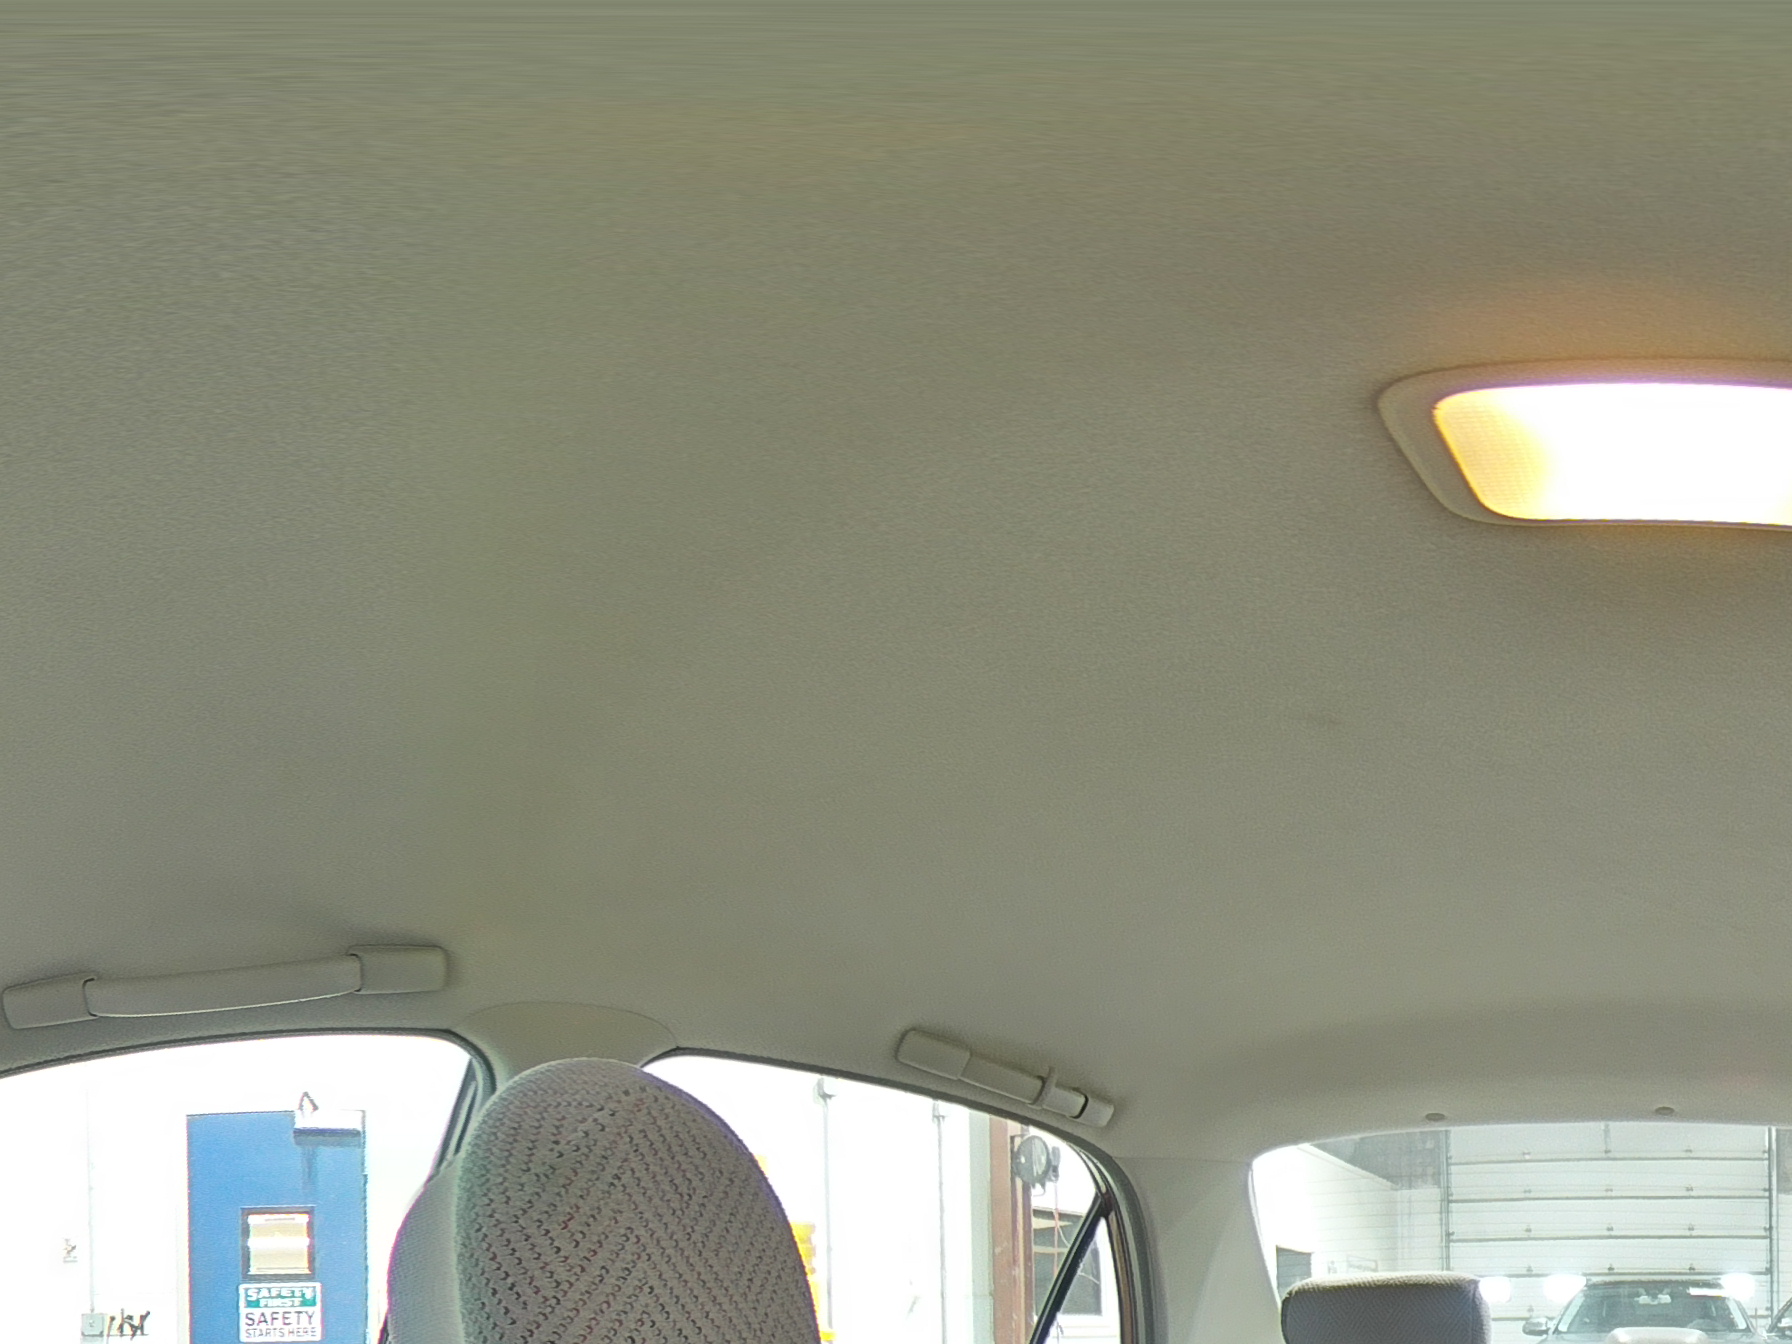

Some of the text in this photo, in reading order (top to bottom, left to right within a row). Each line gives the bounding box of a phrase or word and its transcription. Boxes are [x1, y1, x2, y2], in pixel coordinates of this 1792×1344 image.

[247, 1287, 314, 1301] SAFETY
[260, 1298, 302, 1307] FIRST
[245, 1311, 315, 1326] SAFETY
[245, 1327, 317, 1338] STARTS HERE
